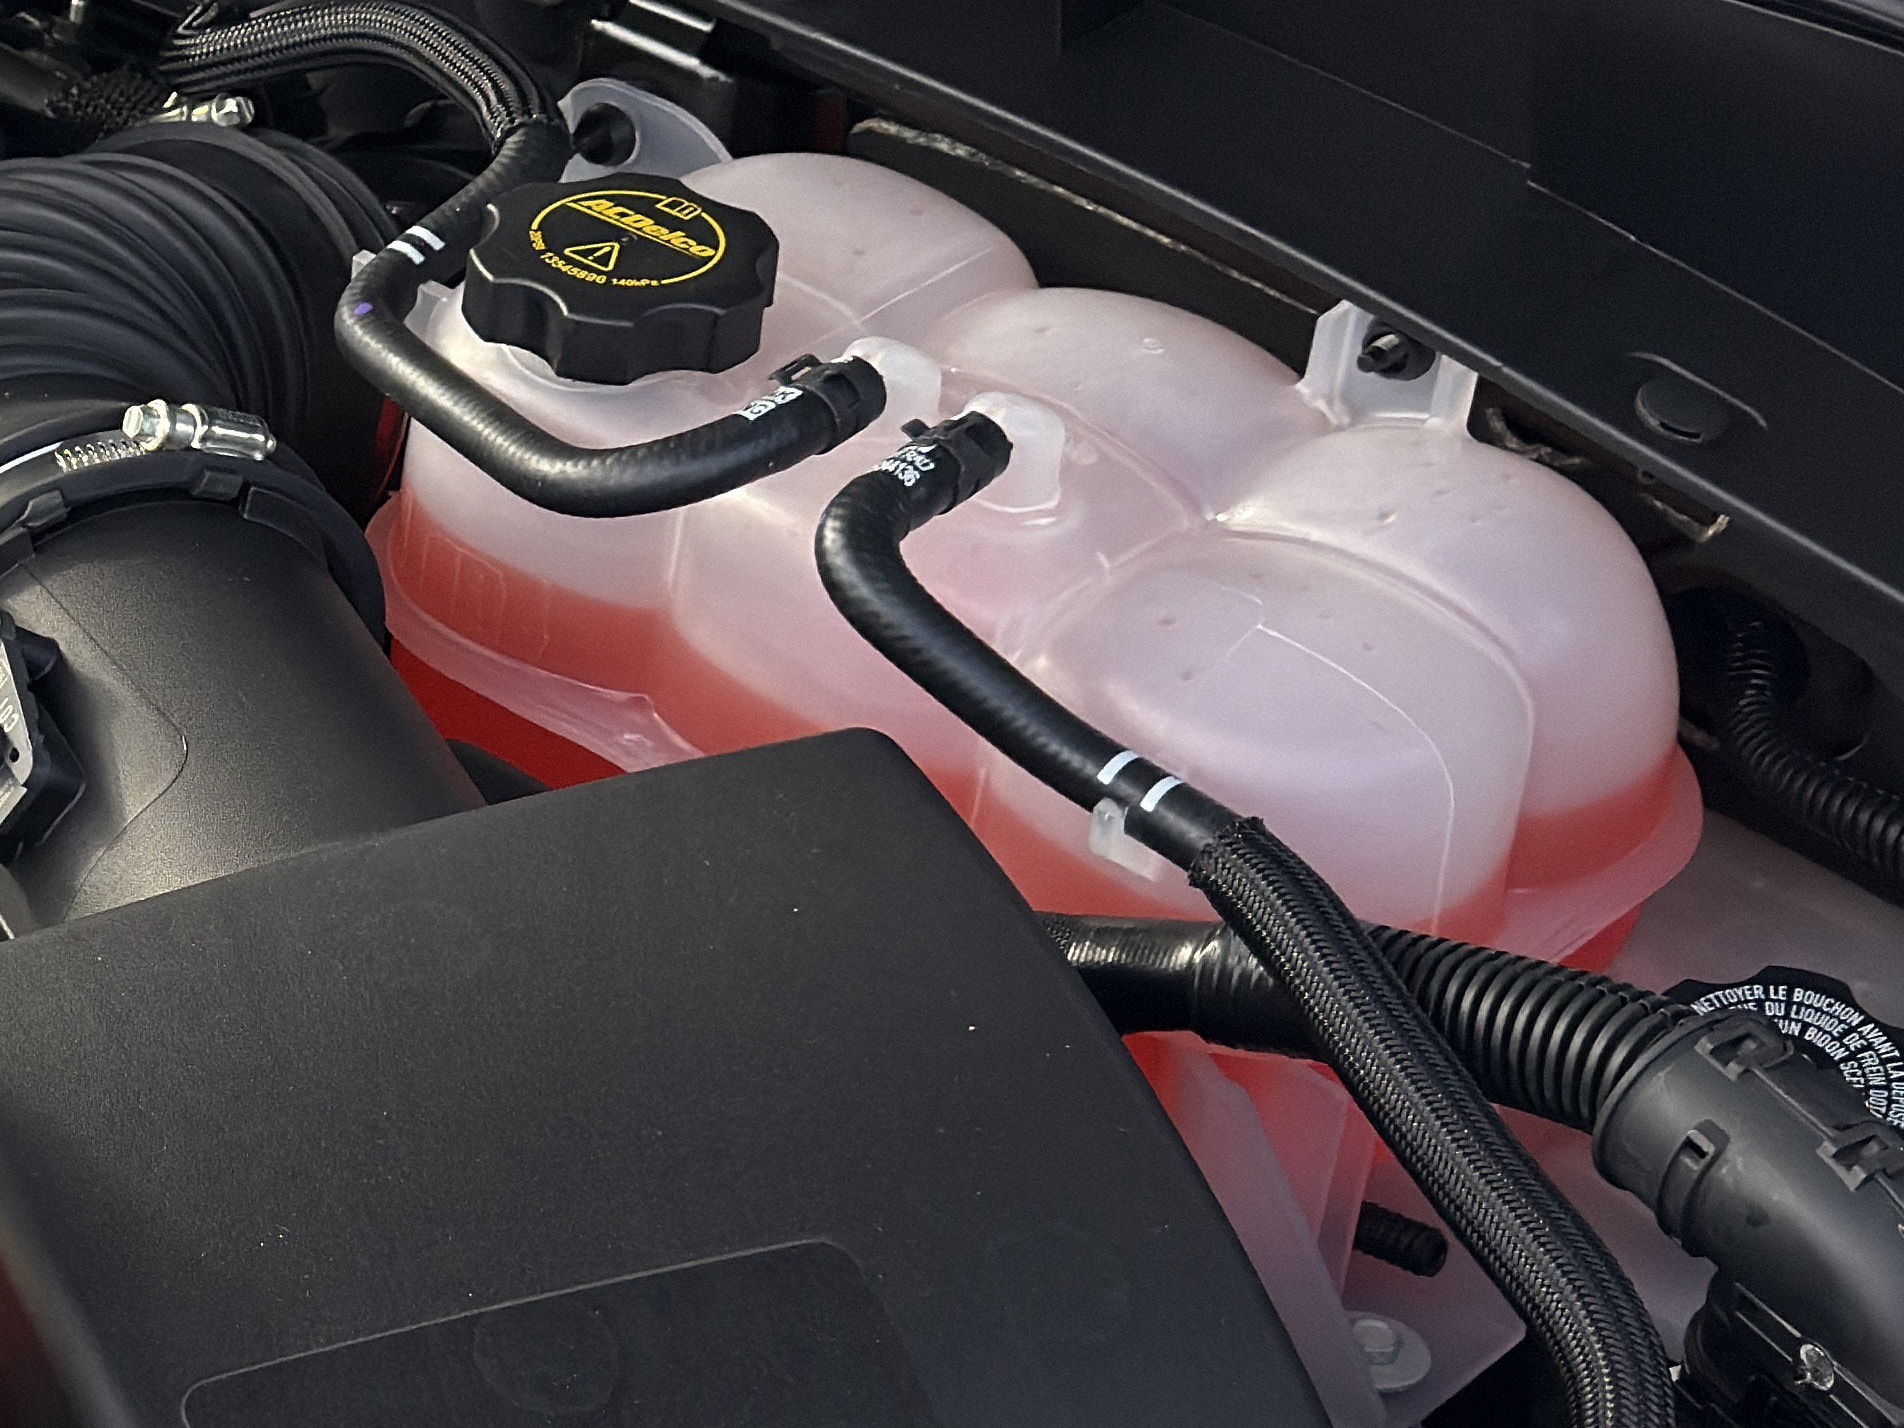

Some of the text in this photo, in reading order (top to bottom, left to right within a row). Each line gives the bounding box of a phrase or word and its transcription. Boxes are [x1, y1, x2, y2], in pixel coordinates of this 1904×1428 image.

[578, 199, 716, 257] ACDelco
[1690, 983, 1766, 1017] NETTOYER
[1769, 984, 1788, 1001] LE
[1792, 987, 1865, 1027] BOUCHON
[1857, 1022, 1901, 1059] AVANT
[1885, 1061, 1904, 1079] LA
[1764, 1000, 1786, 1017] DU
[1790, 1004, 1849, 1038] LIQUIDE
[1842, 1032, 1868, 1052] DE
[1855, 1050, 1888, 1086] FREIN
[1803, 1026, 1849, 1062] BIDON
